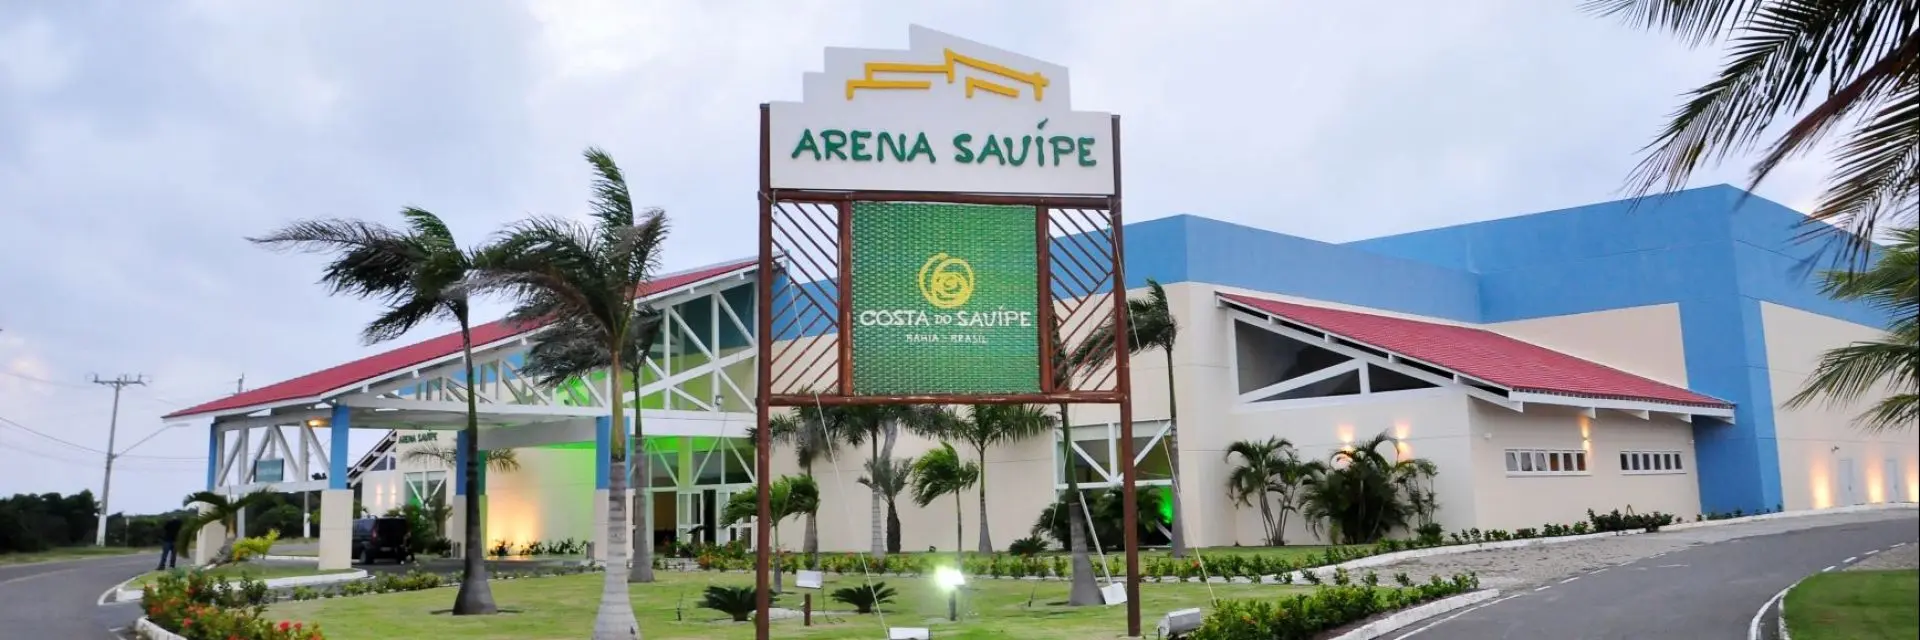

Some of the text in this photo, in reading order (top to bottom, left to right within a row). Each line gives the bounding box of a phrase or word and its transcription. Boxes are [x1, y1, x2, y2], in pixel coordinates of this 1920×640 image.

[791, 118, 1097, 167] ARENA SAUÍPE
[859, 305, 1031, 327] COSTA DO SAUÍPE
[906, 334, 939, 343] BAHIA
[950, 334, 987, 344] BRASIL
